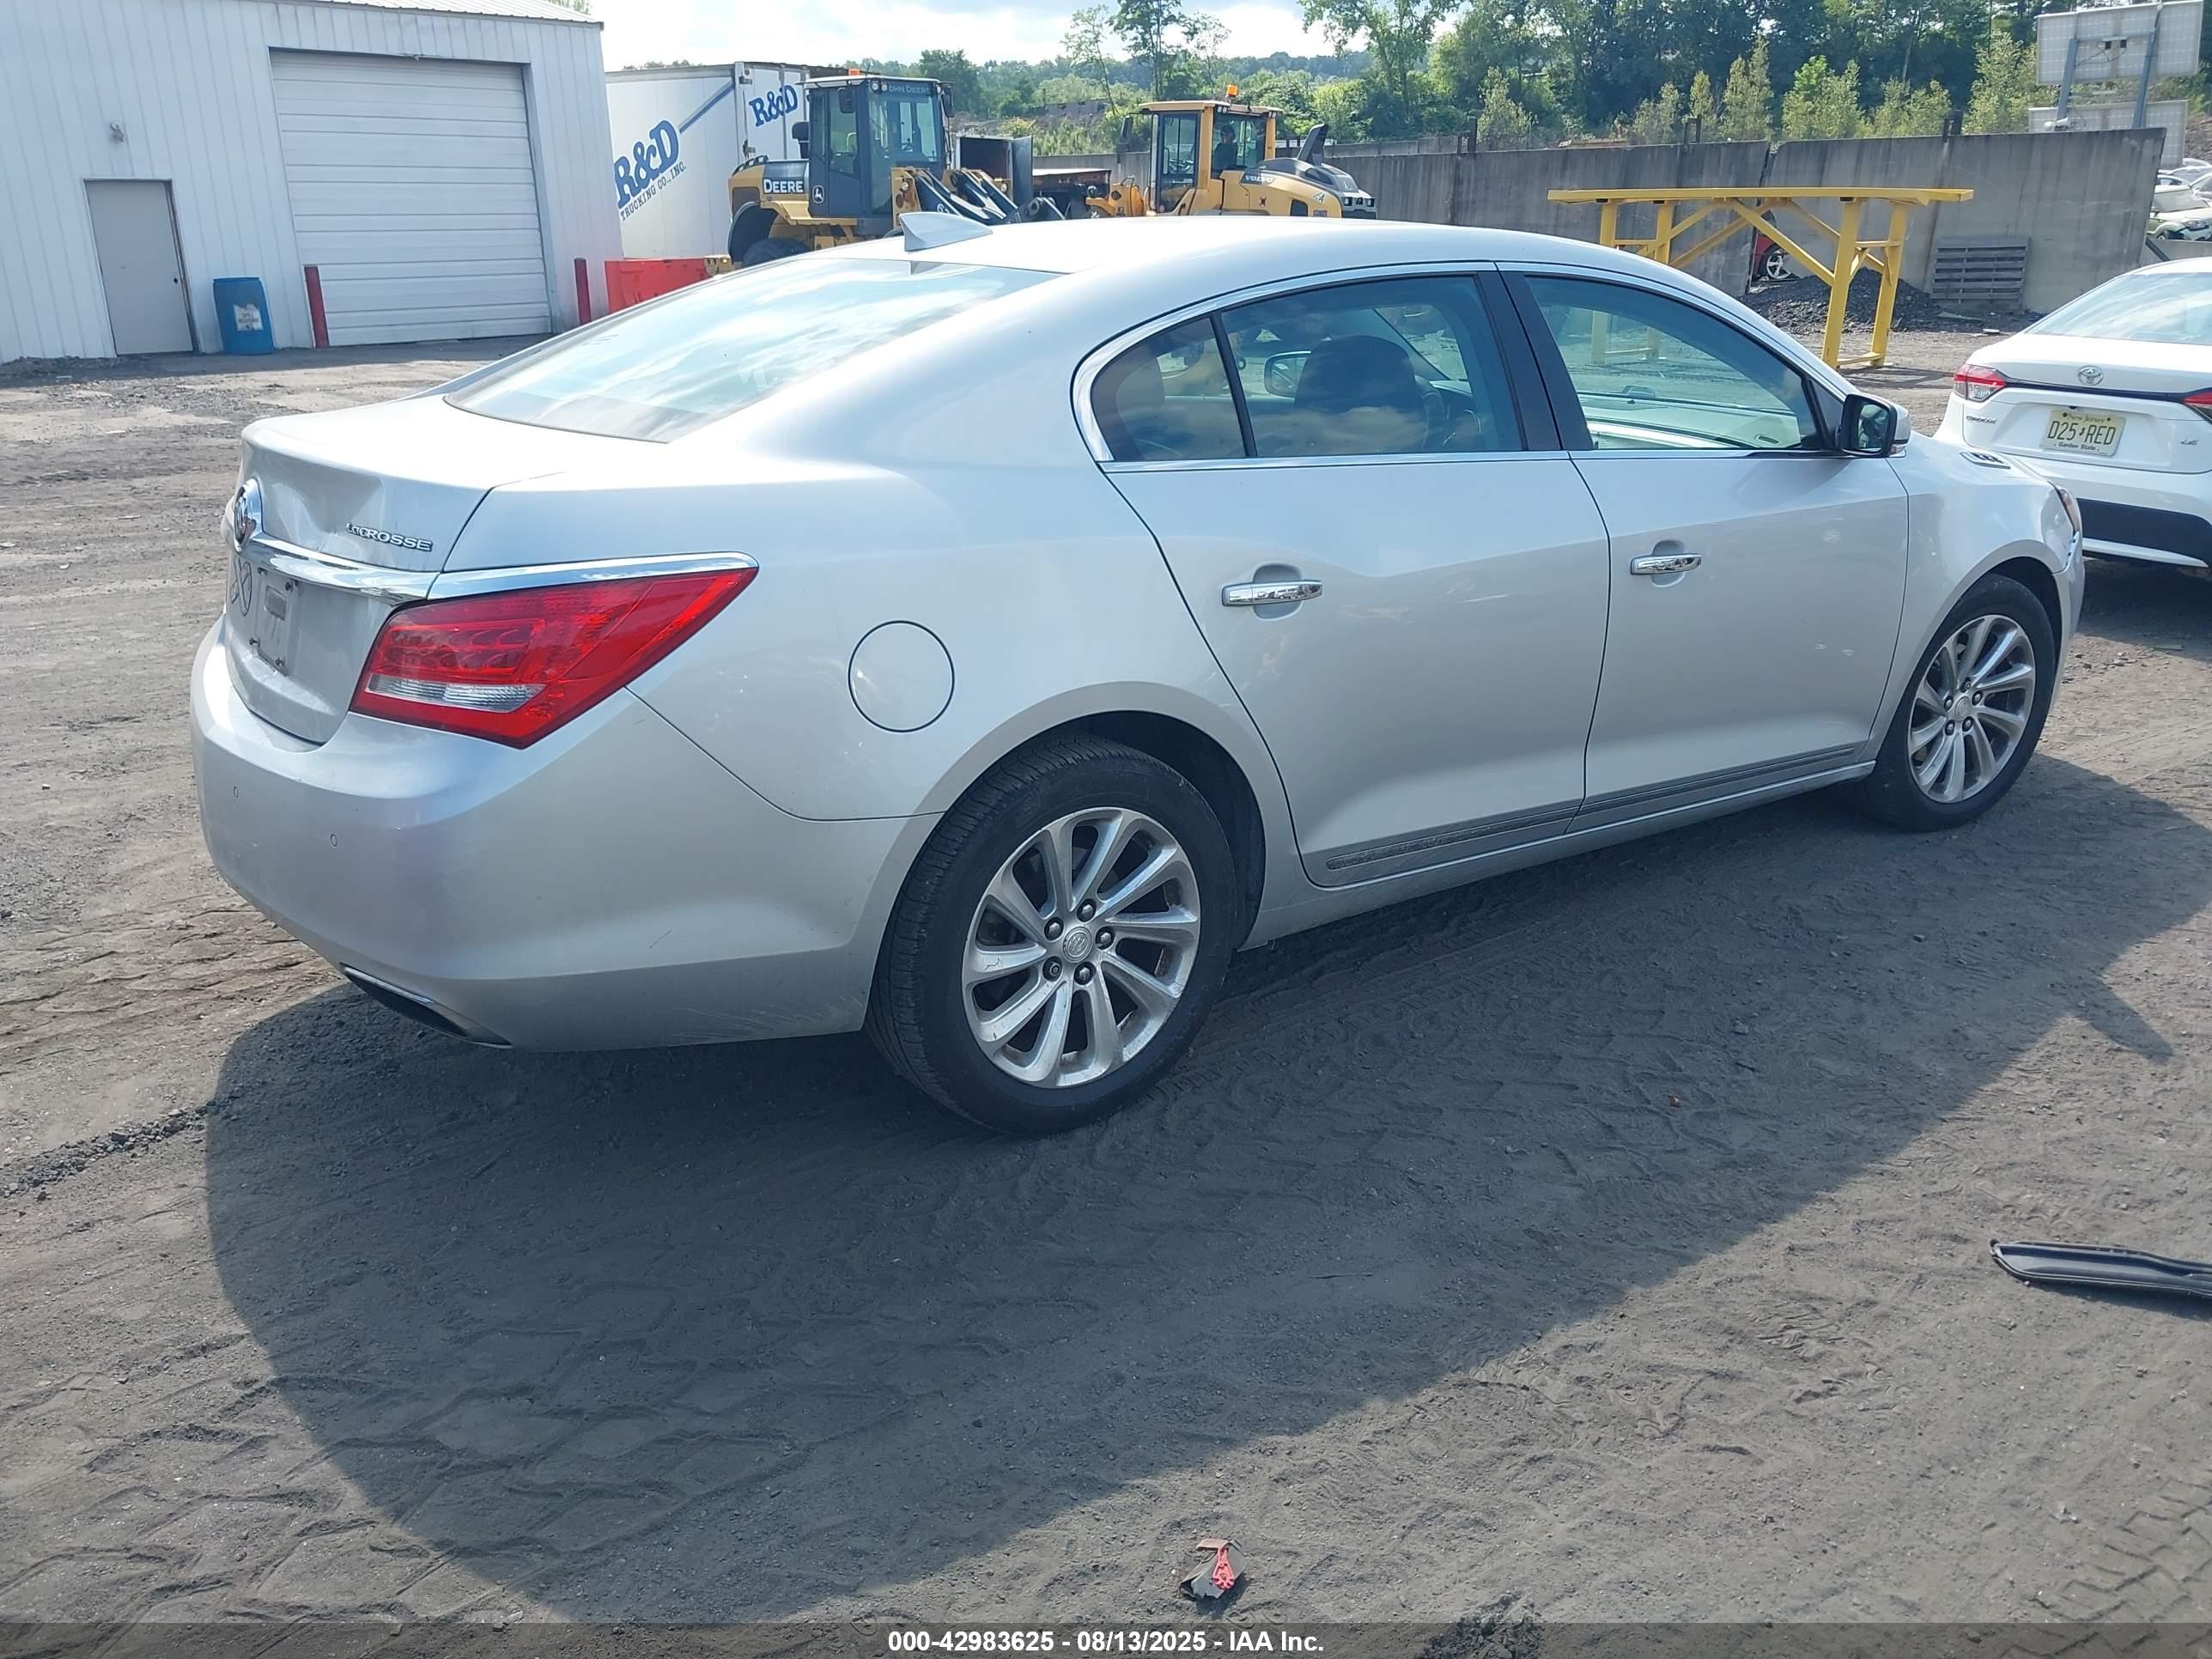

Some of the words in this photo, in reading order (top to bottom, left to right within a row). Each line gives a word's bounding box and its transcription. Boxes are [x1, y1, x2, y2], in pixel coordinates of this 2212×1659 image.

[748, 84, 799, 127] R&D
[614, 119, 679, 209] R&D
[1245, 174, 1273, 183] VOLVO
[620, 185, 657, 222] TRUCKING
[671, 161, 687, 179] INC.
[763, 179, 804, 193] DEERE
